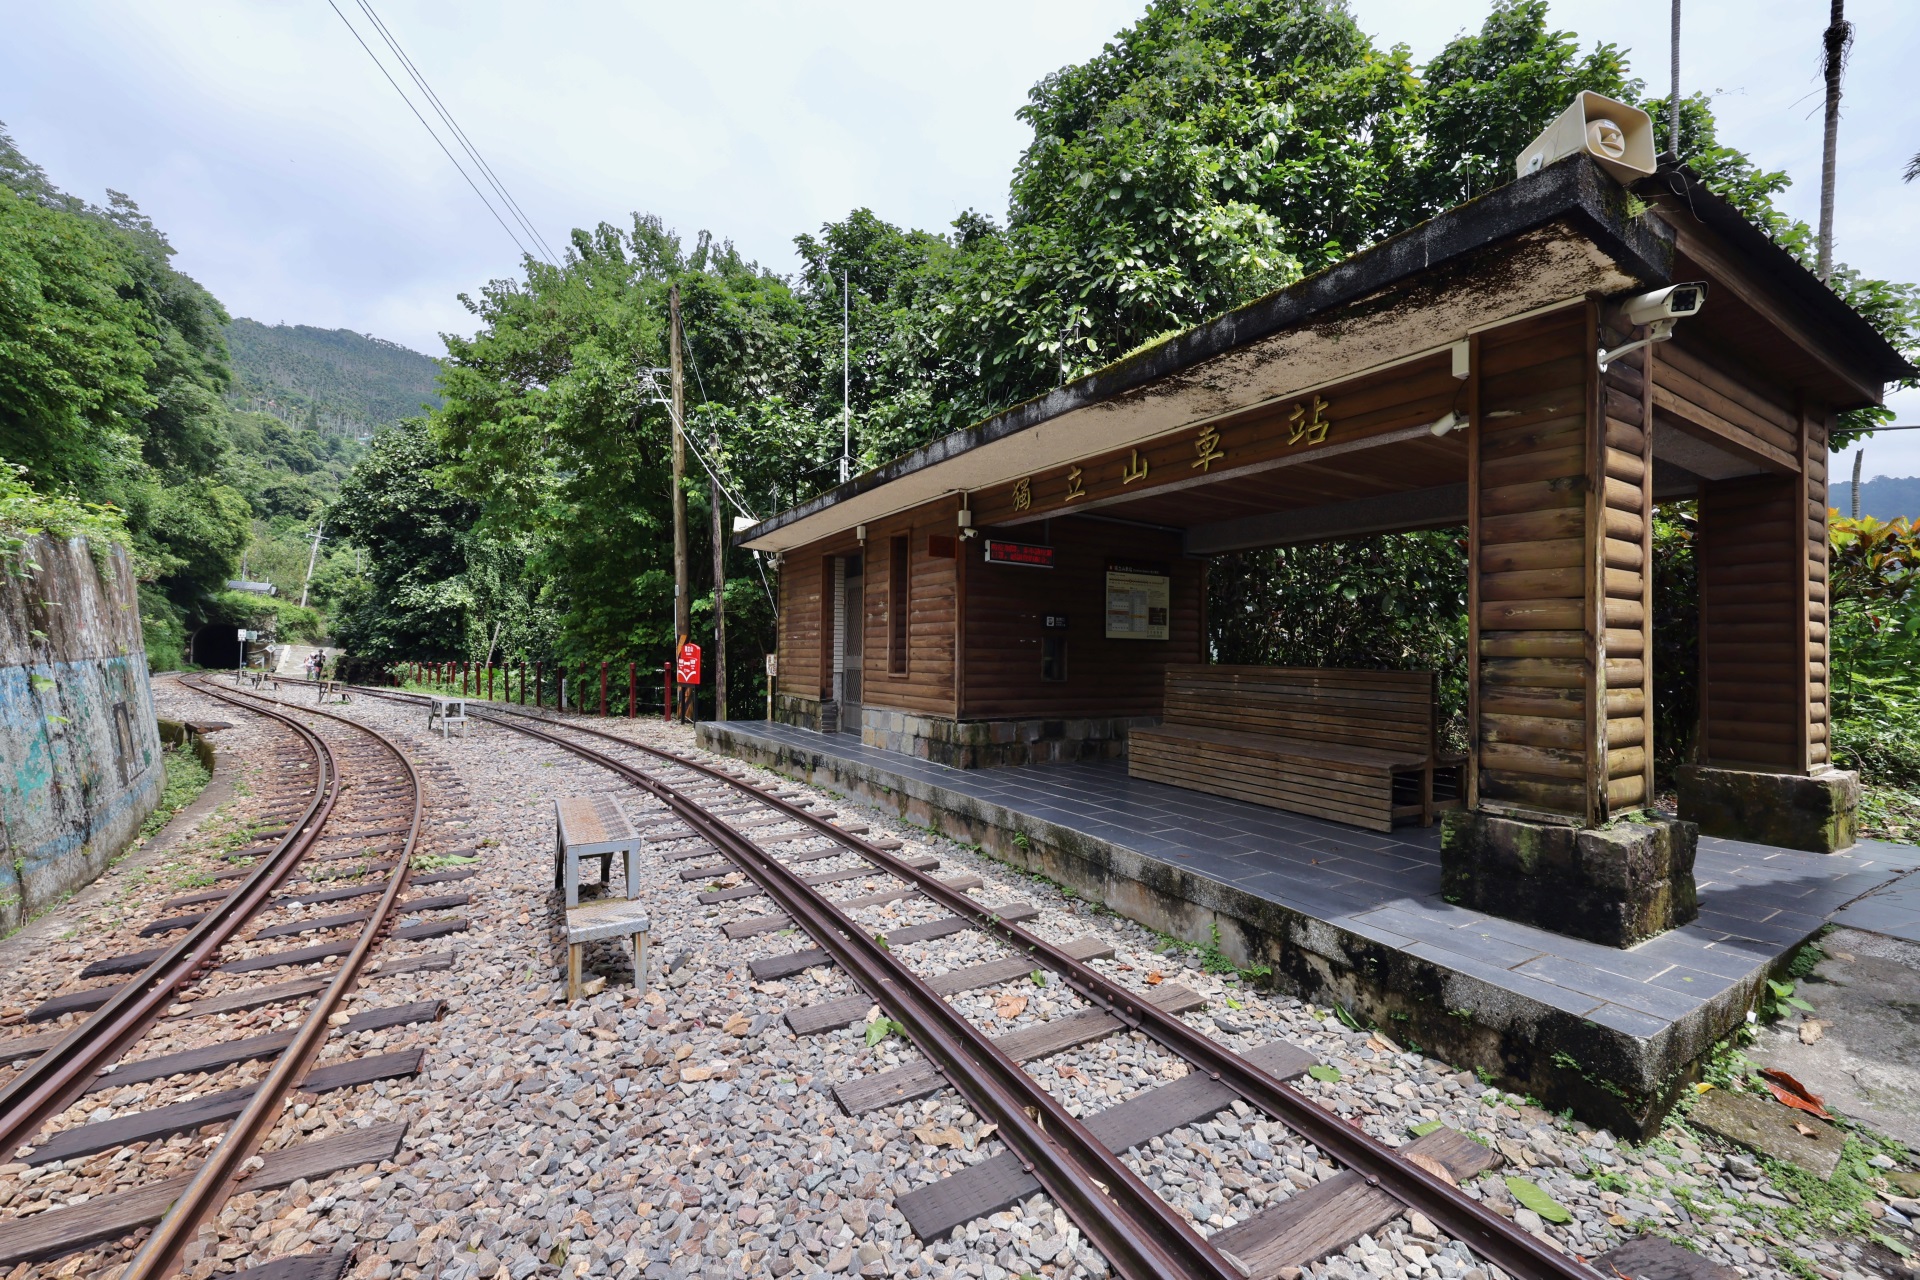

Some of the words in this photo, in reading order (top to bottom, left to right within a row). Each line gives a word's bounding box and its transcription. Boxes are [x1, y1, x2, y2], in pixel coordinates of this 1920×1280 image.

[1013, 395, 1329, 511] 獨立山車站
